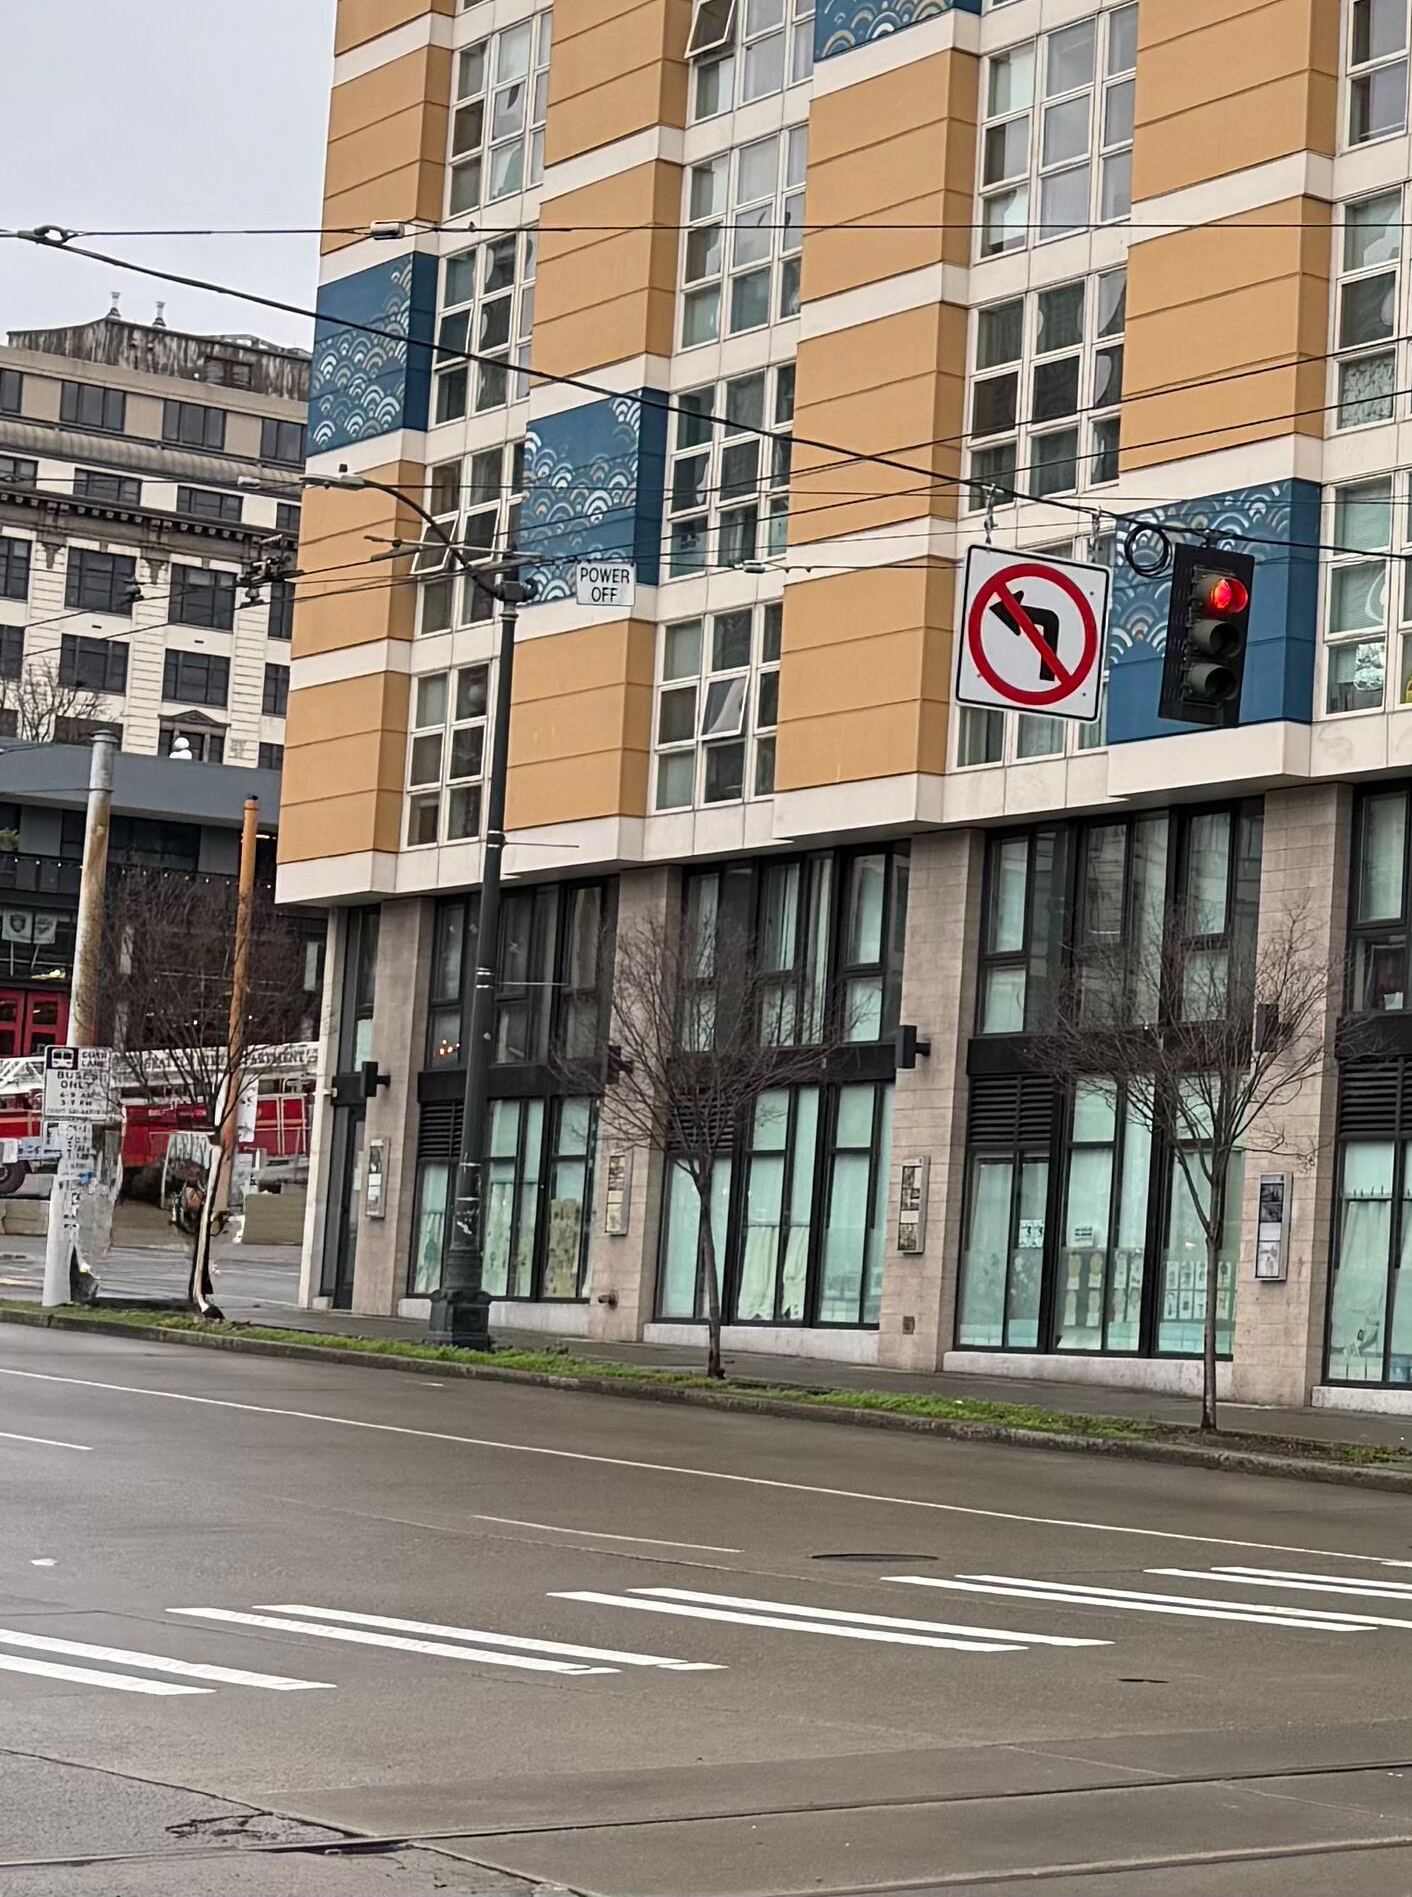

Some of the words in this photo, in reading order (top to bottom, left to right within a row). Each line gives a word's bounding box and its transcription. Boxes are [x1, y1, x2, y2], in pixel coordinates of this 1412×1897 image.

[580, 567, 630, 583] POWER
[591, 586, 619, 602] OFF
[57, 1071, 98, 1080] BUSES
[60, 1080, 93, 1089] ONLY
